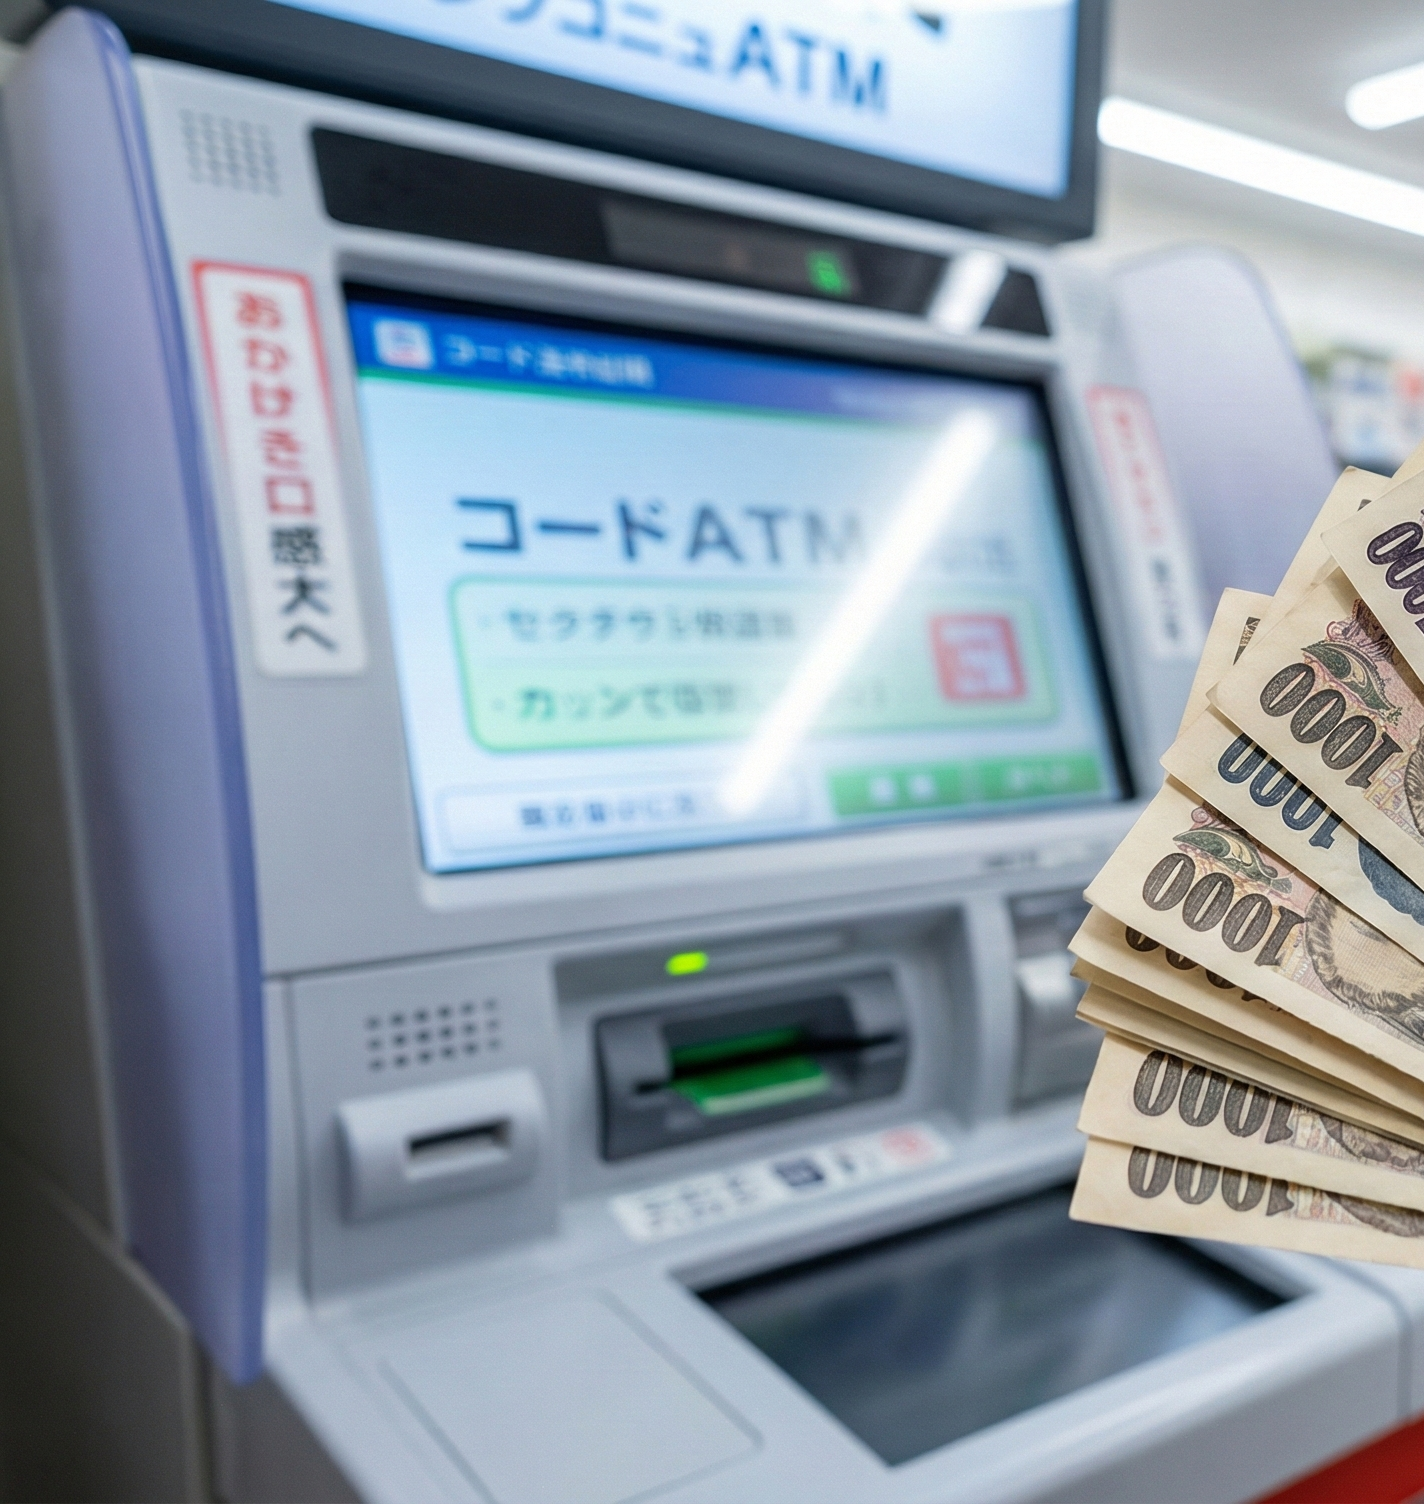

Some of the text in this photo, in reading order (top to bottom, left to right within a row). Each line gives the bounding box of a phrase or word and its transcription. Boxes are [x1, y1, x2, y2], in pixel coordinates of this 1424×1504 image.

[1259, 662, 1404, 790] 1000
[1141, 852, 1309, 968] 1000
[1133, 1049, 1294, 1144] 1000
